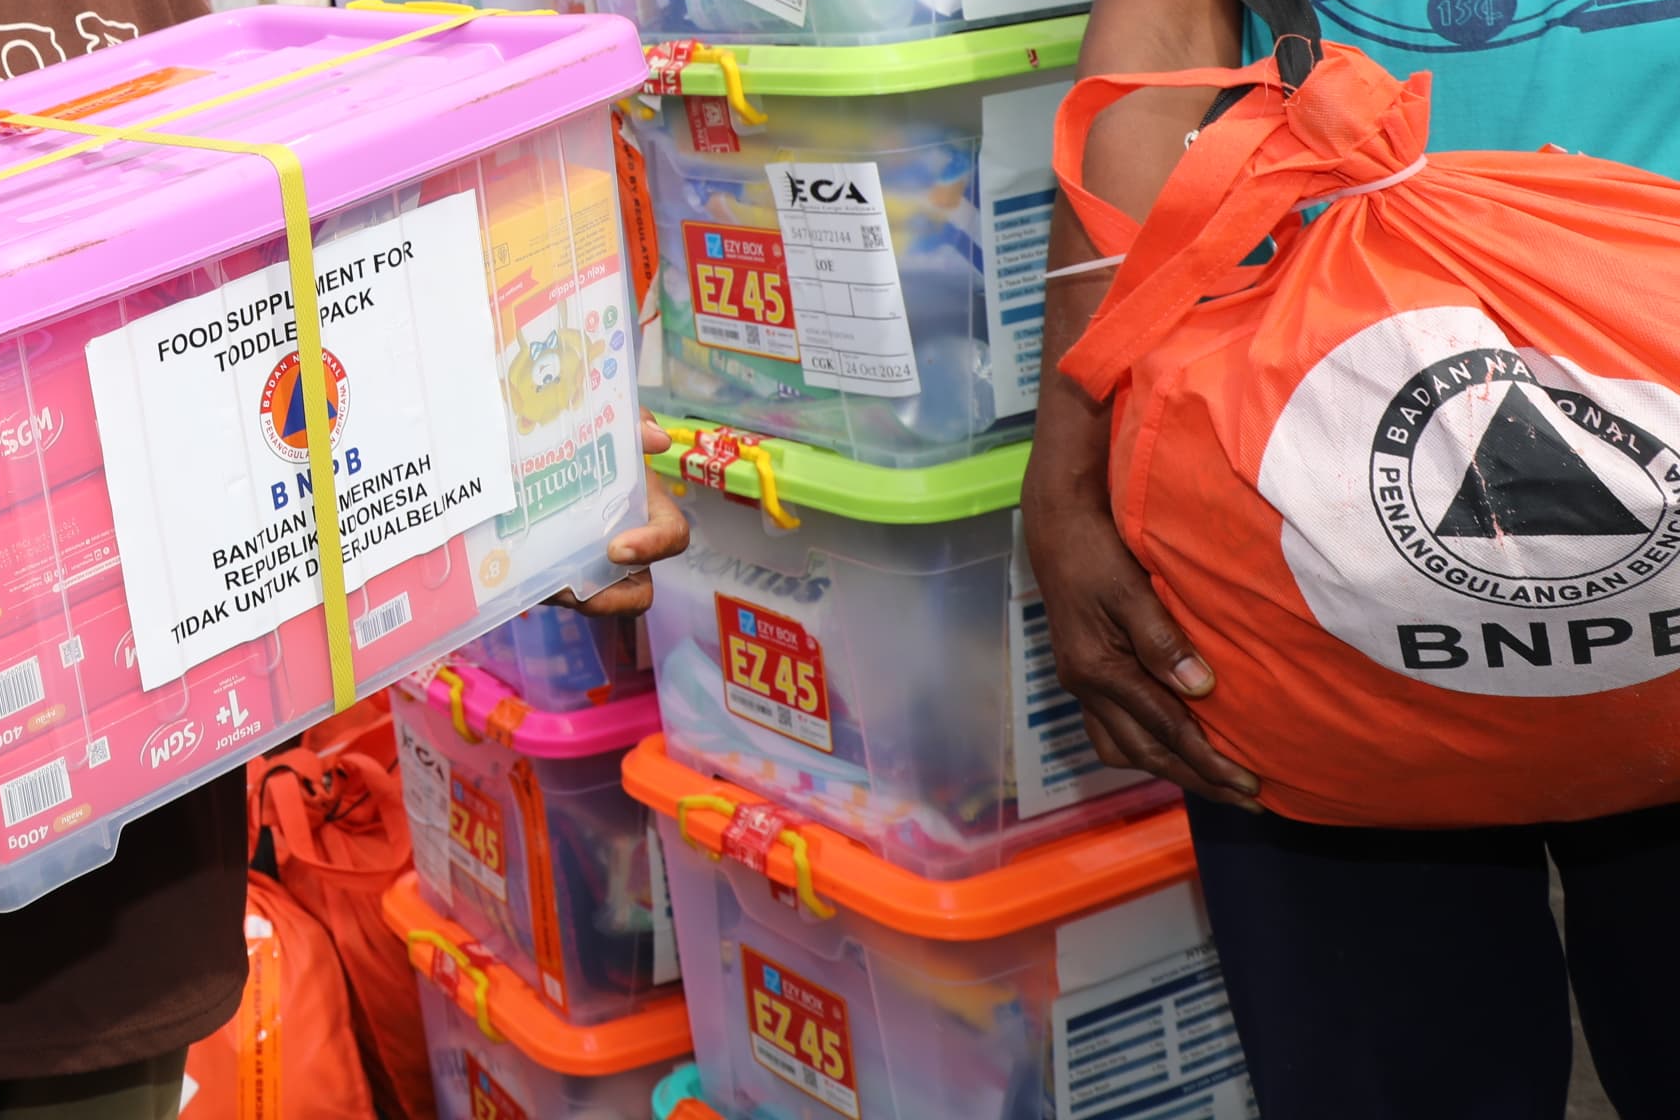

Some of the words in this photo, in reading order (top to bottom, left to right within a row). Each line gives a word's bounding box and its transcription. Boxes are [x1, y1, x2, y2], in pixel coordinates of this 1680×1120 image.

[784, 171, 869, 208] ECA
[724, 239, 741, 254] EZY
[742, 242, 765, 257] BOX
[157, 320, 223, 363] FOOD
[226, 259, 366, 333] SUPPLMENT
[373, 241, 414, 273] FOR
[696, 263, 739, 317] EZ
[742, 270, 785, 324] 45
[214, 320, 298, 373] TODDLE
[319, 288, 375, 329] PACK
[263, 363, 288, 408] BADAN
[878, 363, 912, 378] 2024
[1387, 363, 1474, 445] BADAN
[0, 406, 54, 457] SGM
[212, 510, 308, 570] BANTUAN
[224, 533, 319, 590] REPUBLIK
[338, 482, 429, 538] NDONESIA
[1378, 465, 1628, 605] PENANGGULANGAN
[170, 600, 229, 645] TIDAK
[235, 567, 302, 613] UNTUK
[757, 619, 775, 636] EZY
[776, 626, 799, 645] BOX
[729, 635, 770, 697] EZ
[775, 655, 819, 712] 45
[215, 689, 250, 729] 1+
[150, 721, 198, 769] SGM
[215, 720, 263, 753] Eksplor
[8, 824, 50, 850] 400g
[473, 821, 500, 871] 45
[753, 988, 796, 1055] EZ
[799, 1018, 845, 1080] 45
